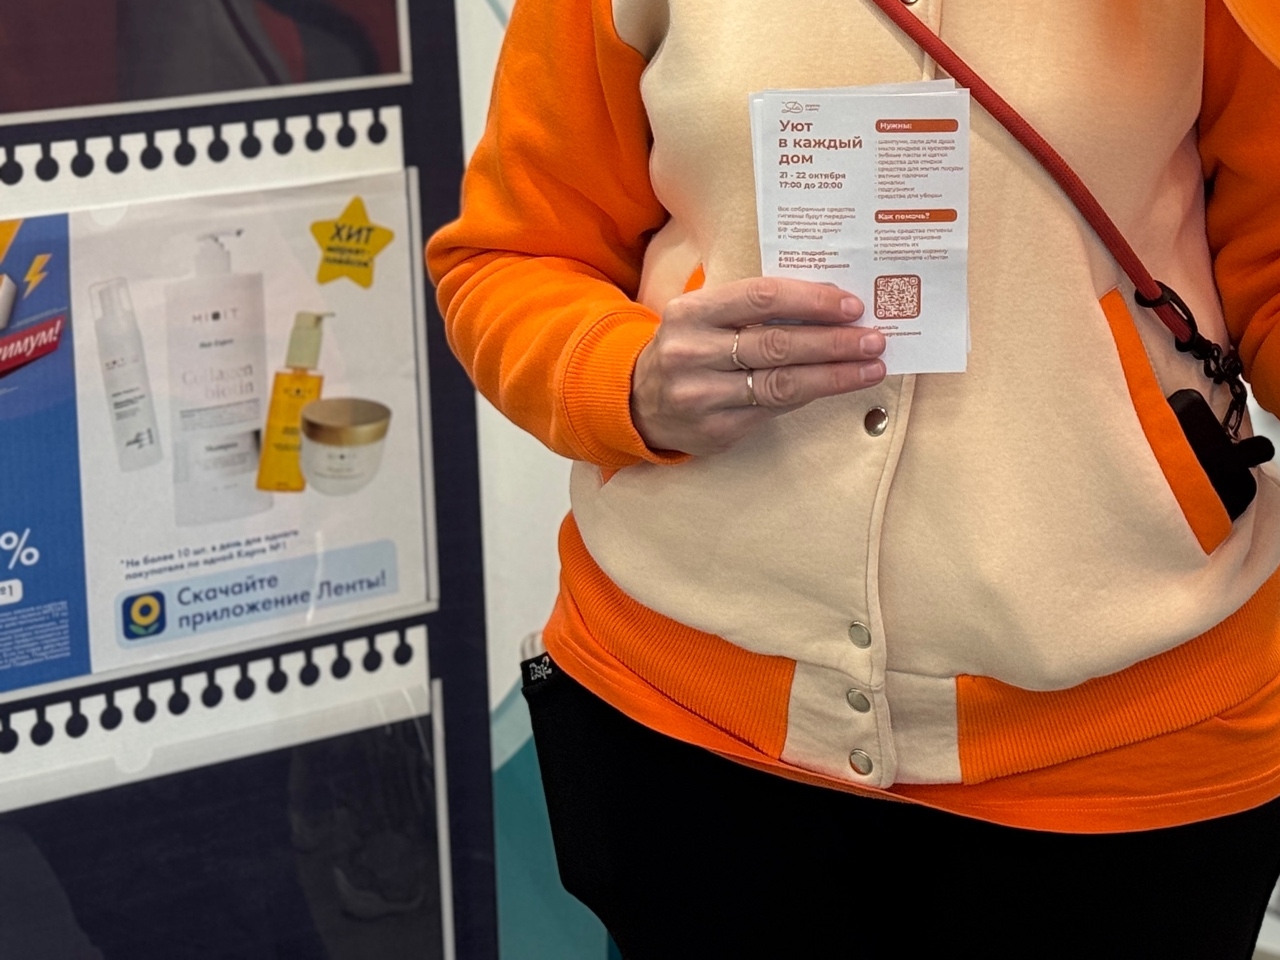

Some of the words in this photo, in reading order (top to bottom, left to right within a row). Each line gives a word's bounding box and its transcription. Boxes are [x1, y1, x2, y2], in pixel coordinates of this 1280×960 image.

[779, 120, 813, 132] Уют
[880, 122, 912, 130] Нужны:
[779, 138, 788, 148] в
[793, 136, 863, 150] каждый
[779, 154, 813, 166] дом
[808, 171, 846, 181] октября
[779, 181, 802, 189] 17:00
[804, 182, 816, 190] до
[330, 223, 374, 244] ХИТ
[0, 319, 62, 362] имум!
[178, 548, 190, 559] 10
[177, 574, 278, 606] Скачайте
[178, 590, 311, 631] приложение
[317, 569, 386, 601] Ленты!
